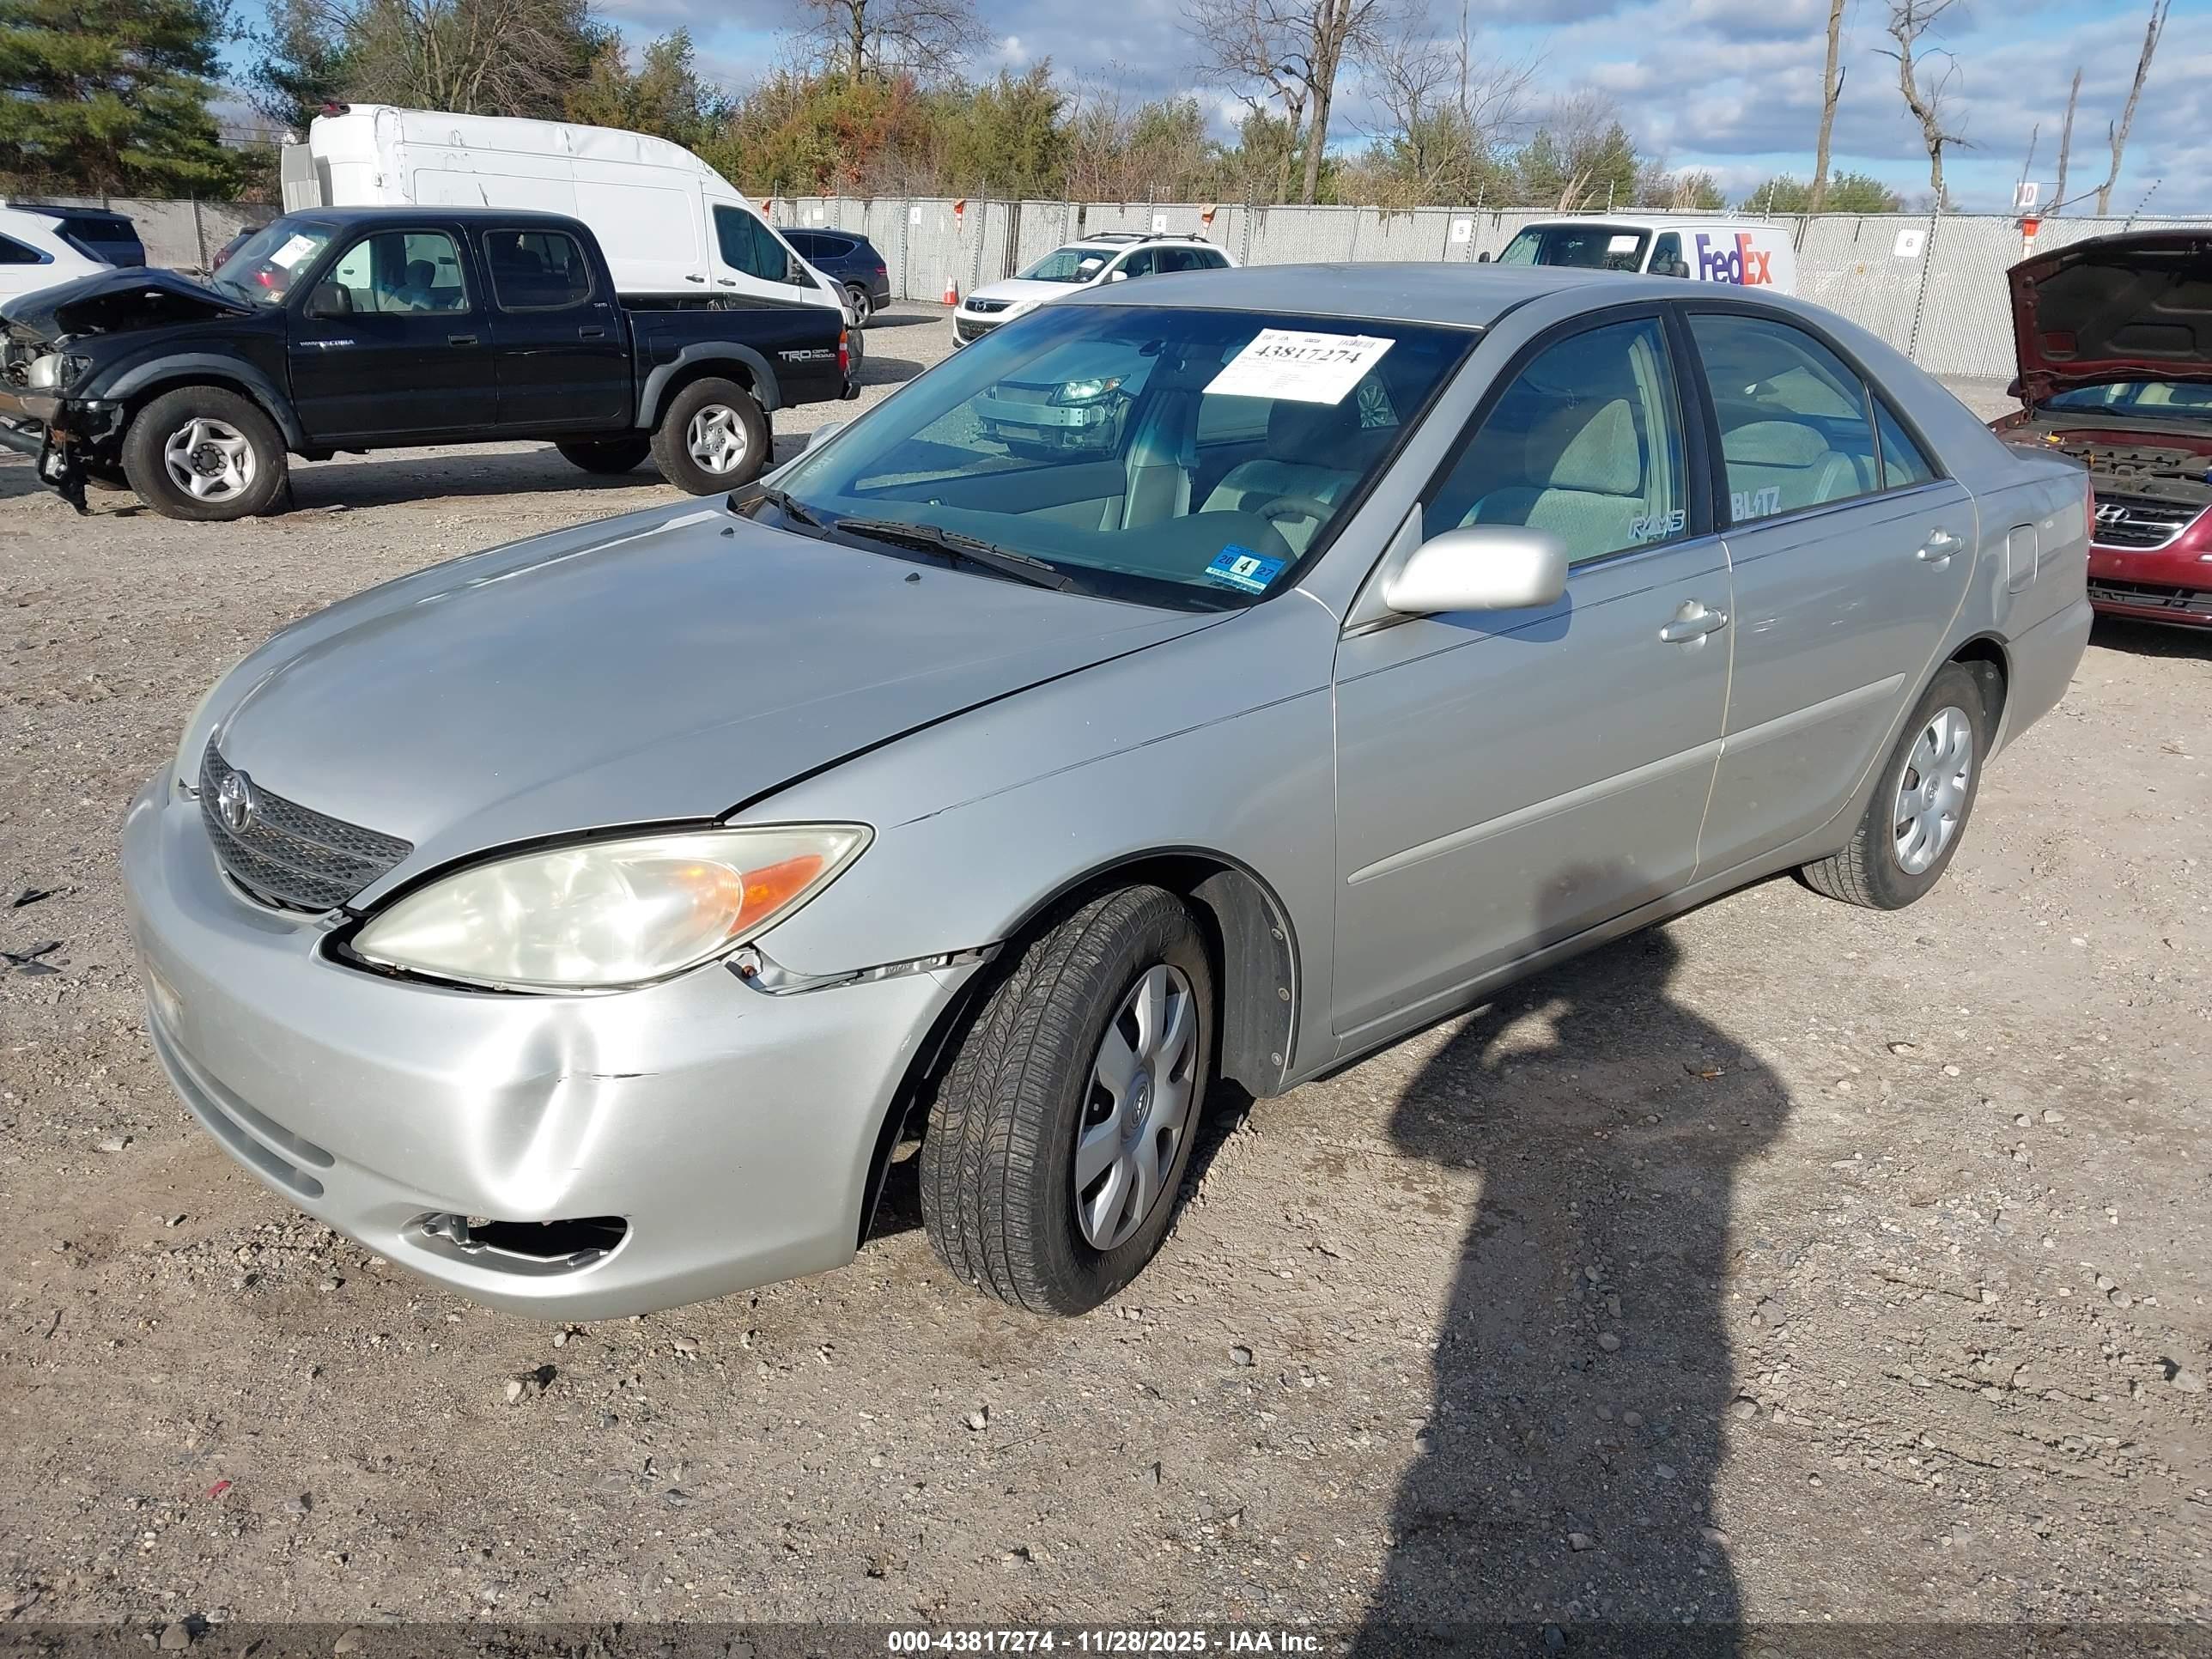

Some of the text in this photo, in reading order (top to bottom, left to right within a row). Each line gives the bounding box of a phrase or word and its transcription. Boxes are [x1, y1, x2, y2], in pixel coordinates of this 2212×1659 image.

[1458, 226, 1465, 235] 5
[1905, 237, 1914, 248] 6
[1695, 233, 1773, 285] FedEx
[777, 349, 811, 362] TRD
[1254, 344, 1363, 364] 43817274
[1218, 554, 1235, 565] 20
[1239, 560, 1253, 574] 4
[1256, 566, 1275, 578] 27
